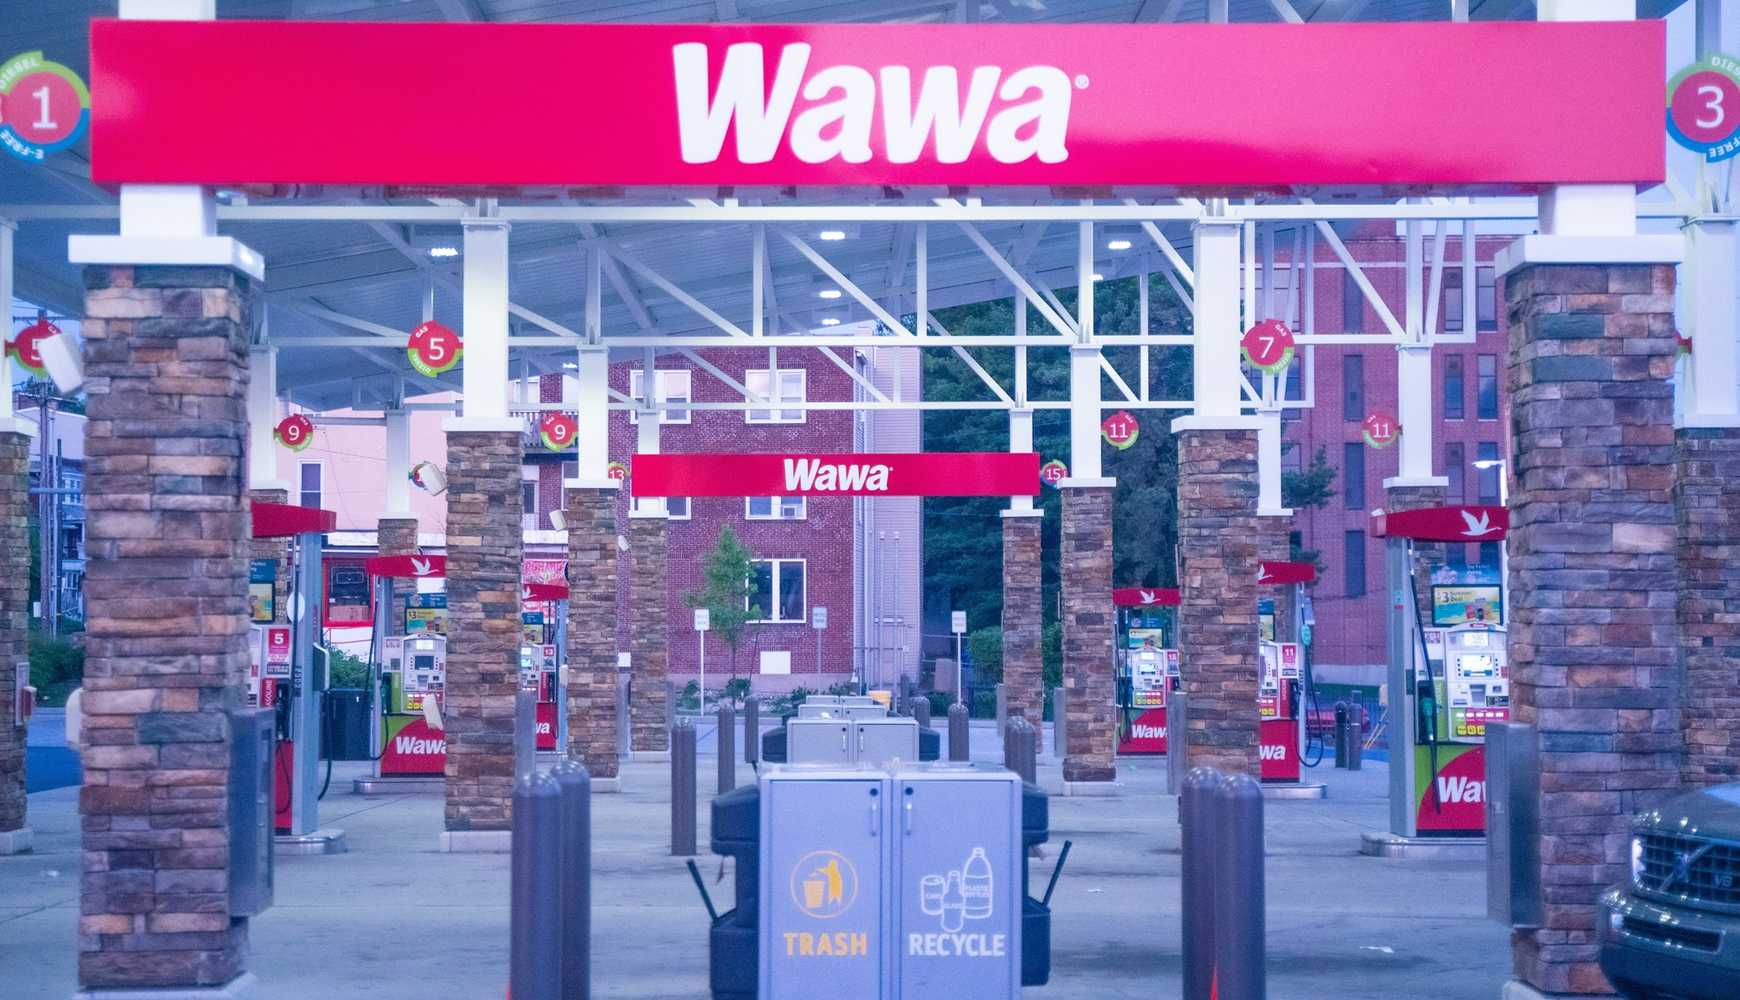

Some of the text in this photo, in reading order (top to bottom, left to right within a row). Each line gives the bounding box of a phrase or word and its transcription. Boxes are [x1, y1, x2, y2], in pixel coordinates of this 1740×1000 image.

[32, 86, 58, 129] 1
[1695, 85, 1726, 129] 3
[429, 337, 445, 361] 5
[1258, 336, 1275, 359] 7
[288, 425, 300, 441] 9
[554, 424, 566, 440] 9
[1109, 422, 1129, 438] 11
[1372, 423, 1392, 438] 11
[609, 469, 624, 480] 13
[1046, 468, 1061, 480] 15
[274, 632, 284, 645] 5
[783, 932, 867, 957] TRASH
[908, 932, 1006, 957] RECYCLE
